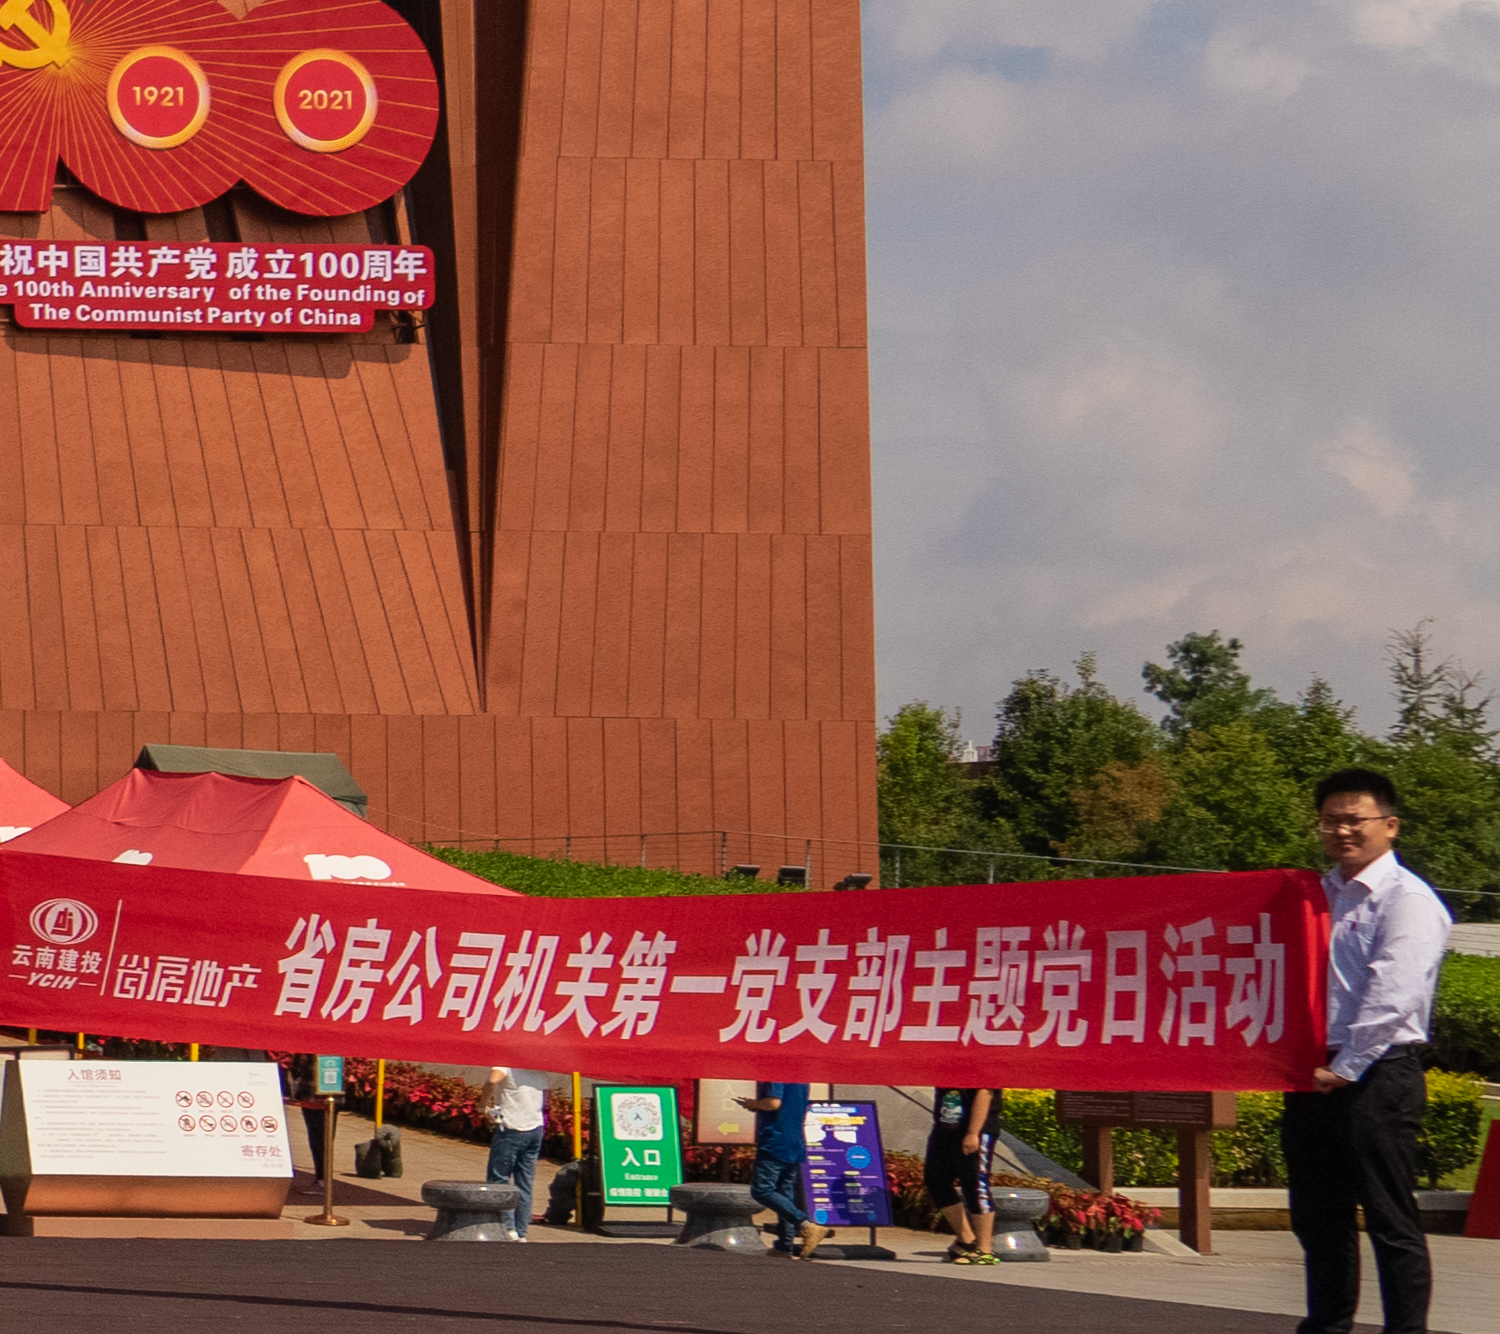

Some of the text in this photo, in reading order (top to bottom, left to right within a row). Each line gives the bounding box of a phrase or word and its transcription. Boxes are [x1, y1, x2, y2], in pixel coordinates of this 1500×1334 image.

[132, 86, 185, 108] 1921
[298, 89, 354, 111] 2021
[14, 280, 74, 297] 100th
[80, 281, 215, 303] Anniversary
[229, 283, 250, 300] of
[255, 284, 291, 301] the
[297, 284, 401, 306] Founding
[404, 289, 425, 306] of
[29, 303, 362, 327] The Communist Party of China
[12, 944, 103, 975] 云南建投
[27, 971, 78, 990] YCIH
[274, 913, 1285, 1049] 省房公司机关第一党支部主题党日活动
[67, 1069, 122, 1081] 入馆须知
[241, 1145, 283, 1157] 寄存处
[621, 1147, 661, 1167] 入口
